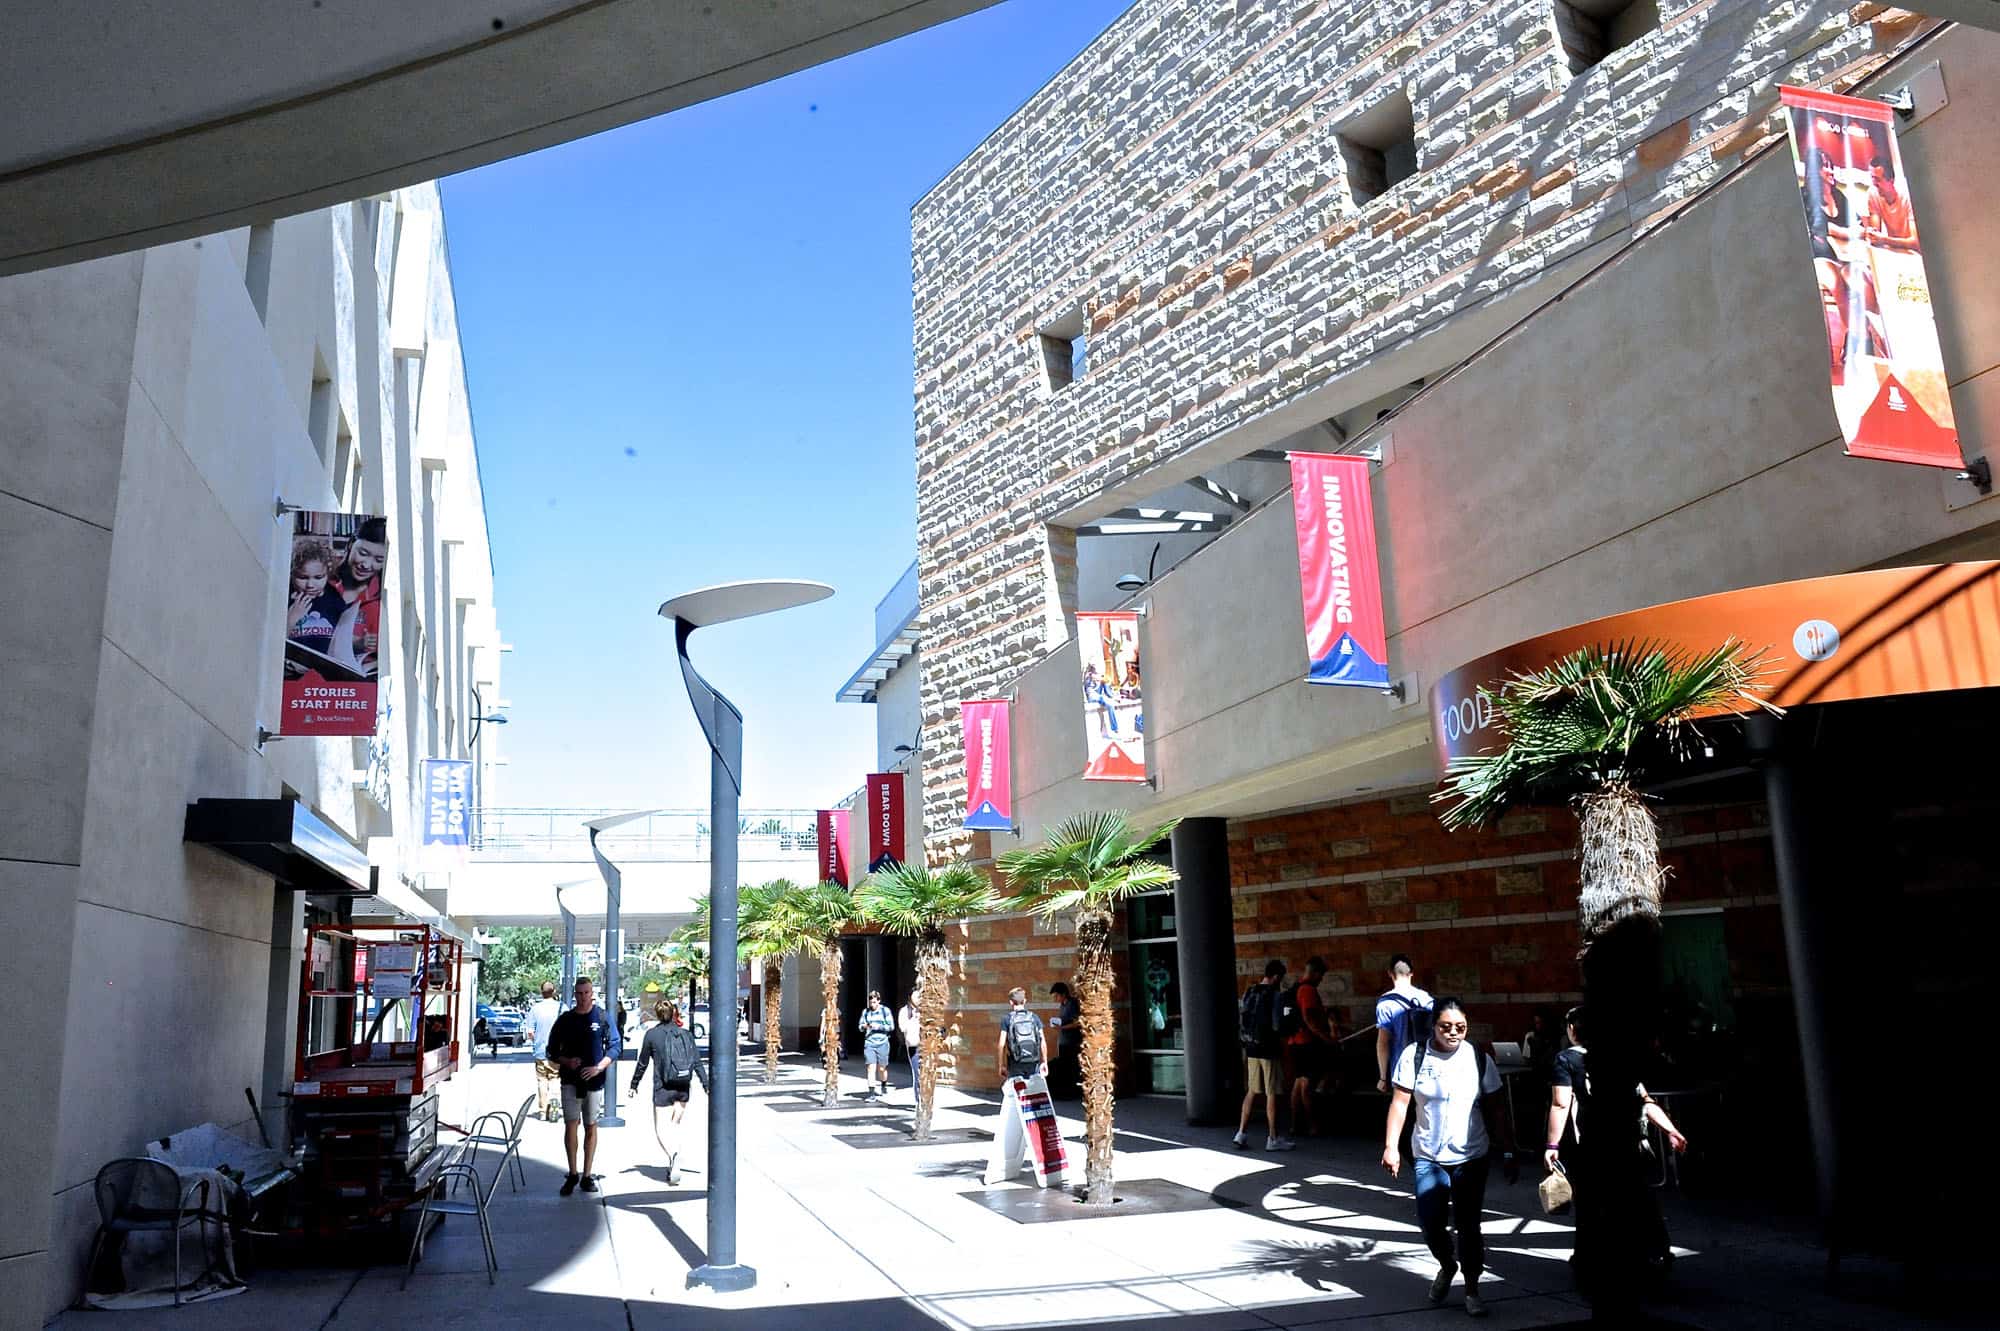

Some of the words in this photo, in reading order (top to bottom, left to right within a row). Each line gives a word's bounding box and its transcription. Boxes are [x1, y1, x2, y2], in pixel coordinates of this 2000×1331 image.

[1321, 475, 1353, 625] INNOVATING
[291, 699, 331, 709] START
[335, 700, 368, 710] HERE
[304, 687, 356, 697] STORIES
[981, 718, 992, 790] ENGAGING
[881, 783, 890, 811] BEAR
[447, 797, 464, 836] FOR
[828, 815, 838, 843] NEVER
[882, 812, 891, 846] DOWN
[829, 844, 837, 873] SETTLE
